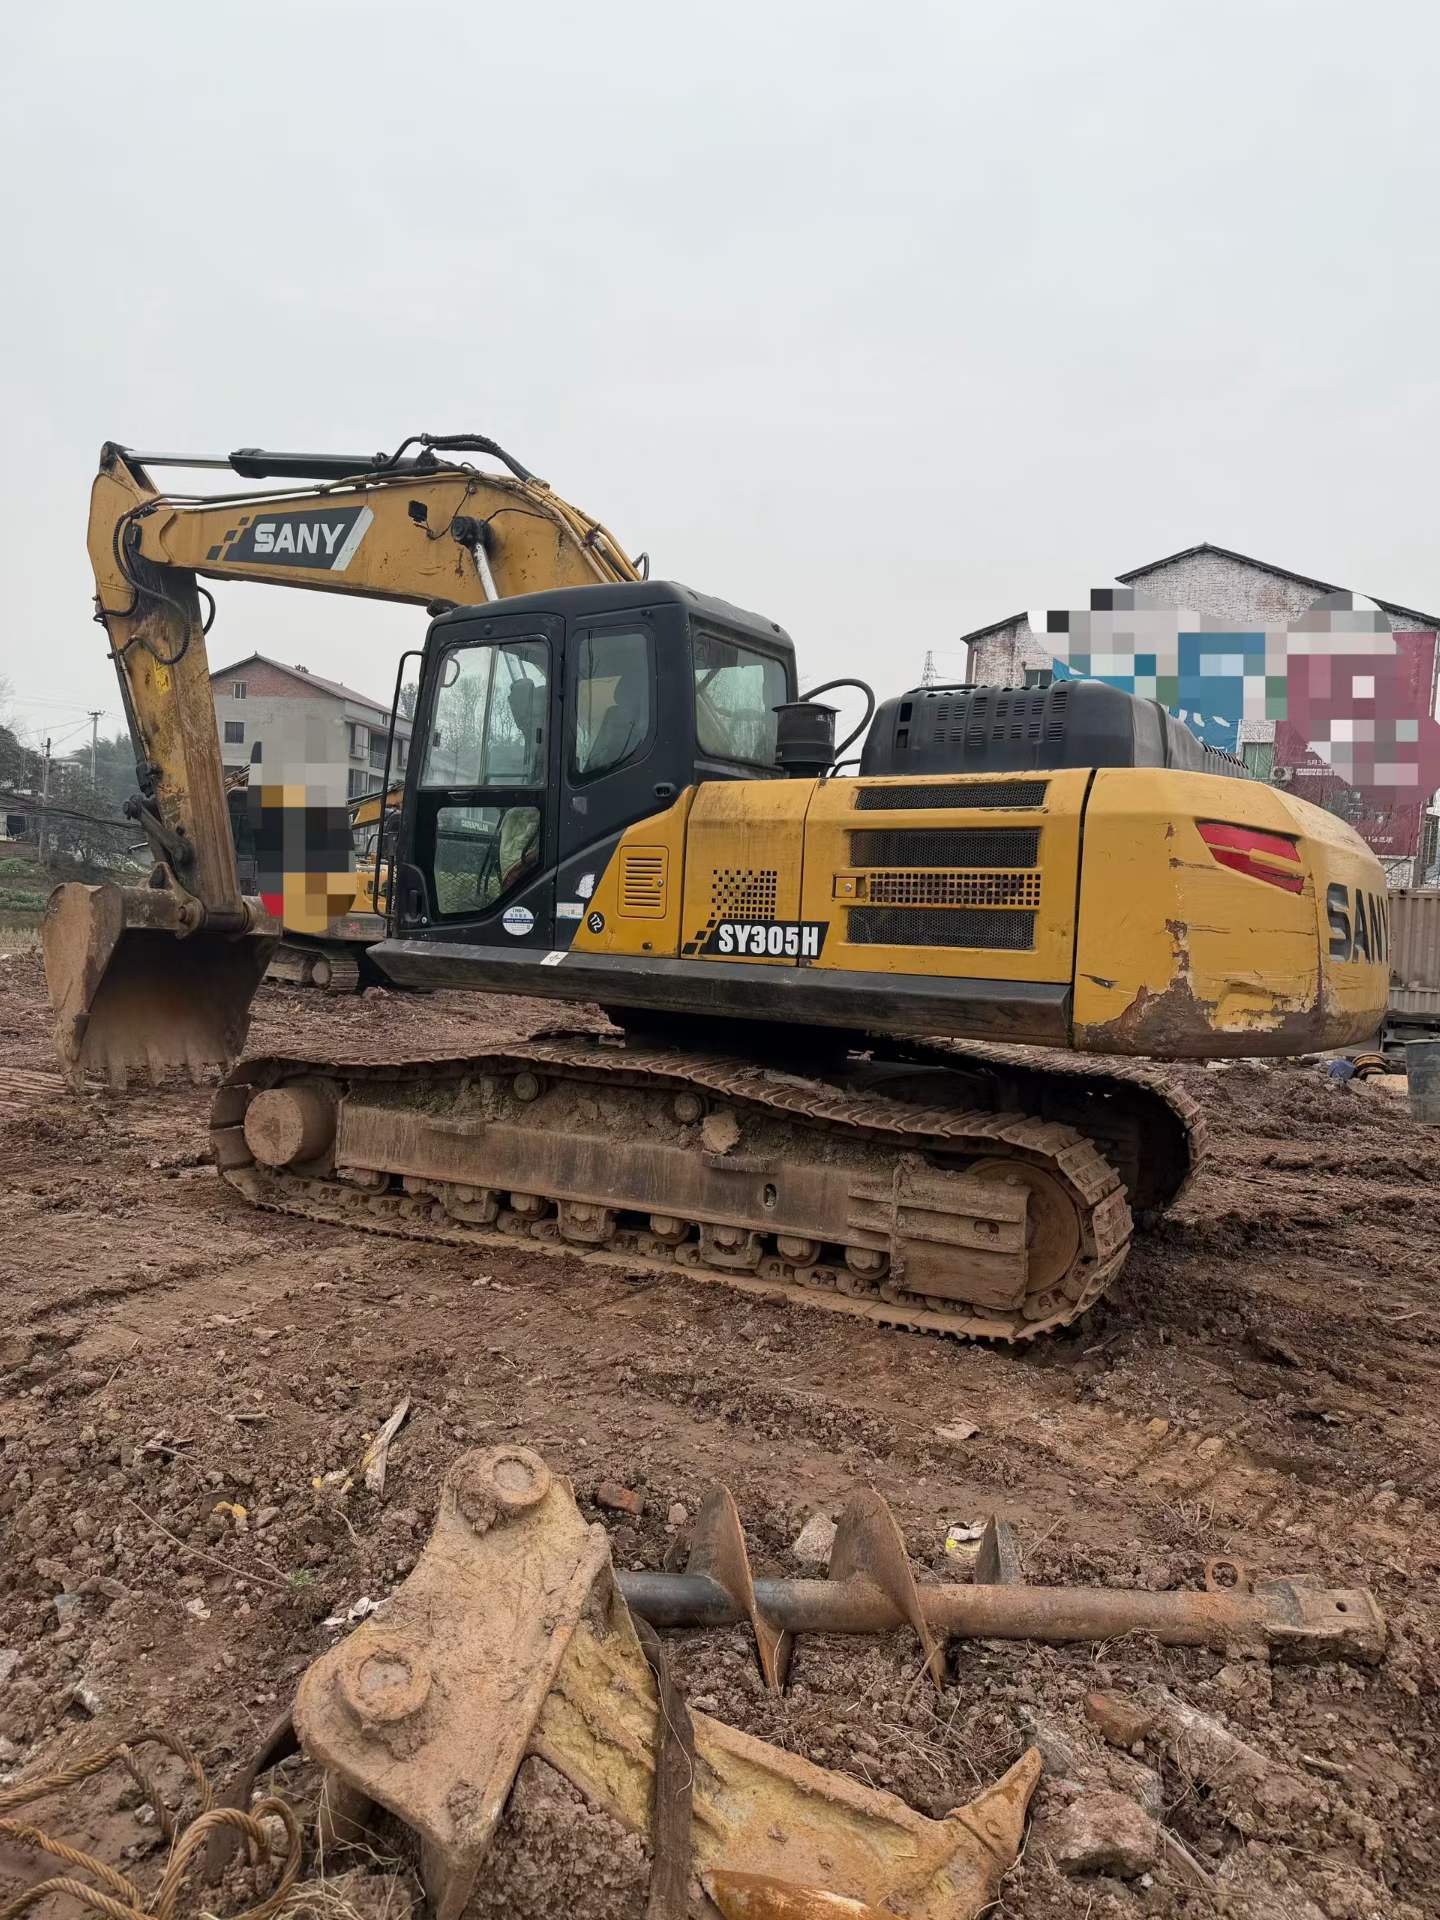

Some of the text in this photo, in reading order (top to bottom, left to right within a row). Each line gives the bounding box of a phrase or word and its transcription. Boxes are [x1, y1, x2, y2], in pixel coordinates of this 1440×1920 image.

[253, 523, 345, 554] SANY
[590, 914, 602, 931] 172
[718, 924, 819, 956] SY305H
